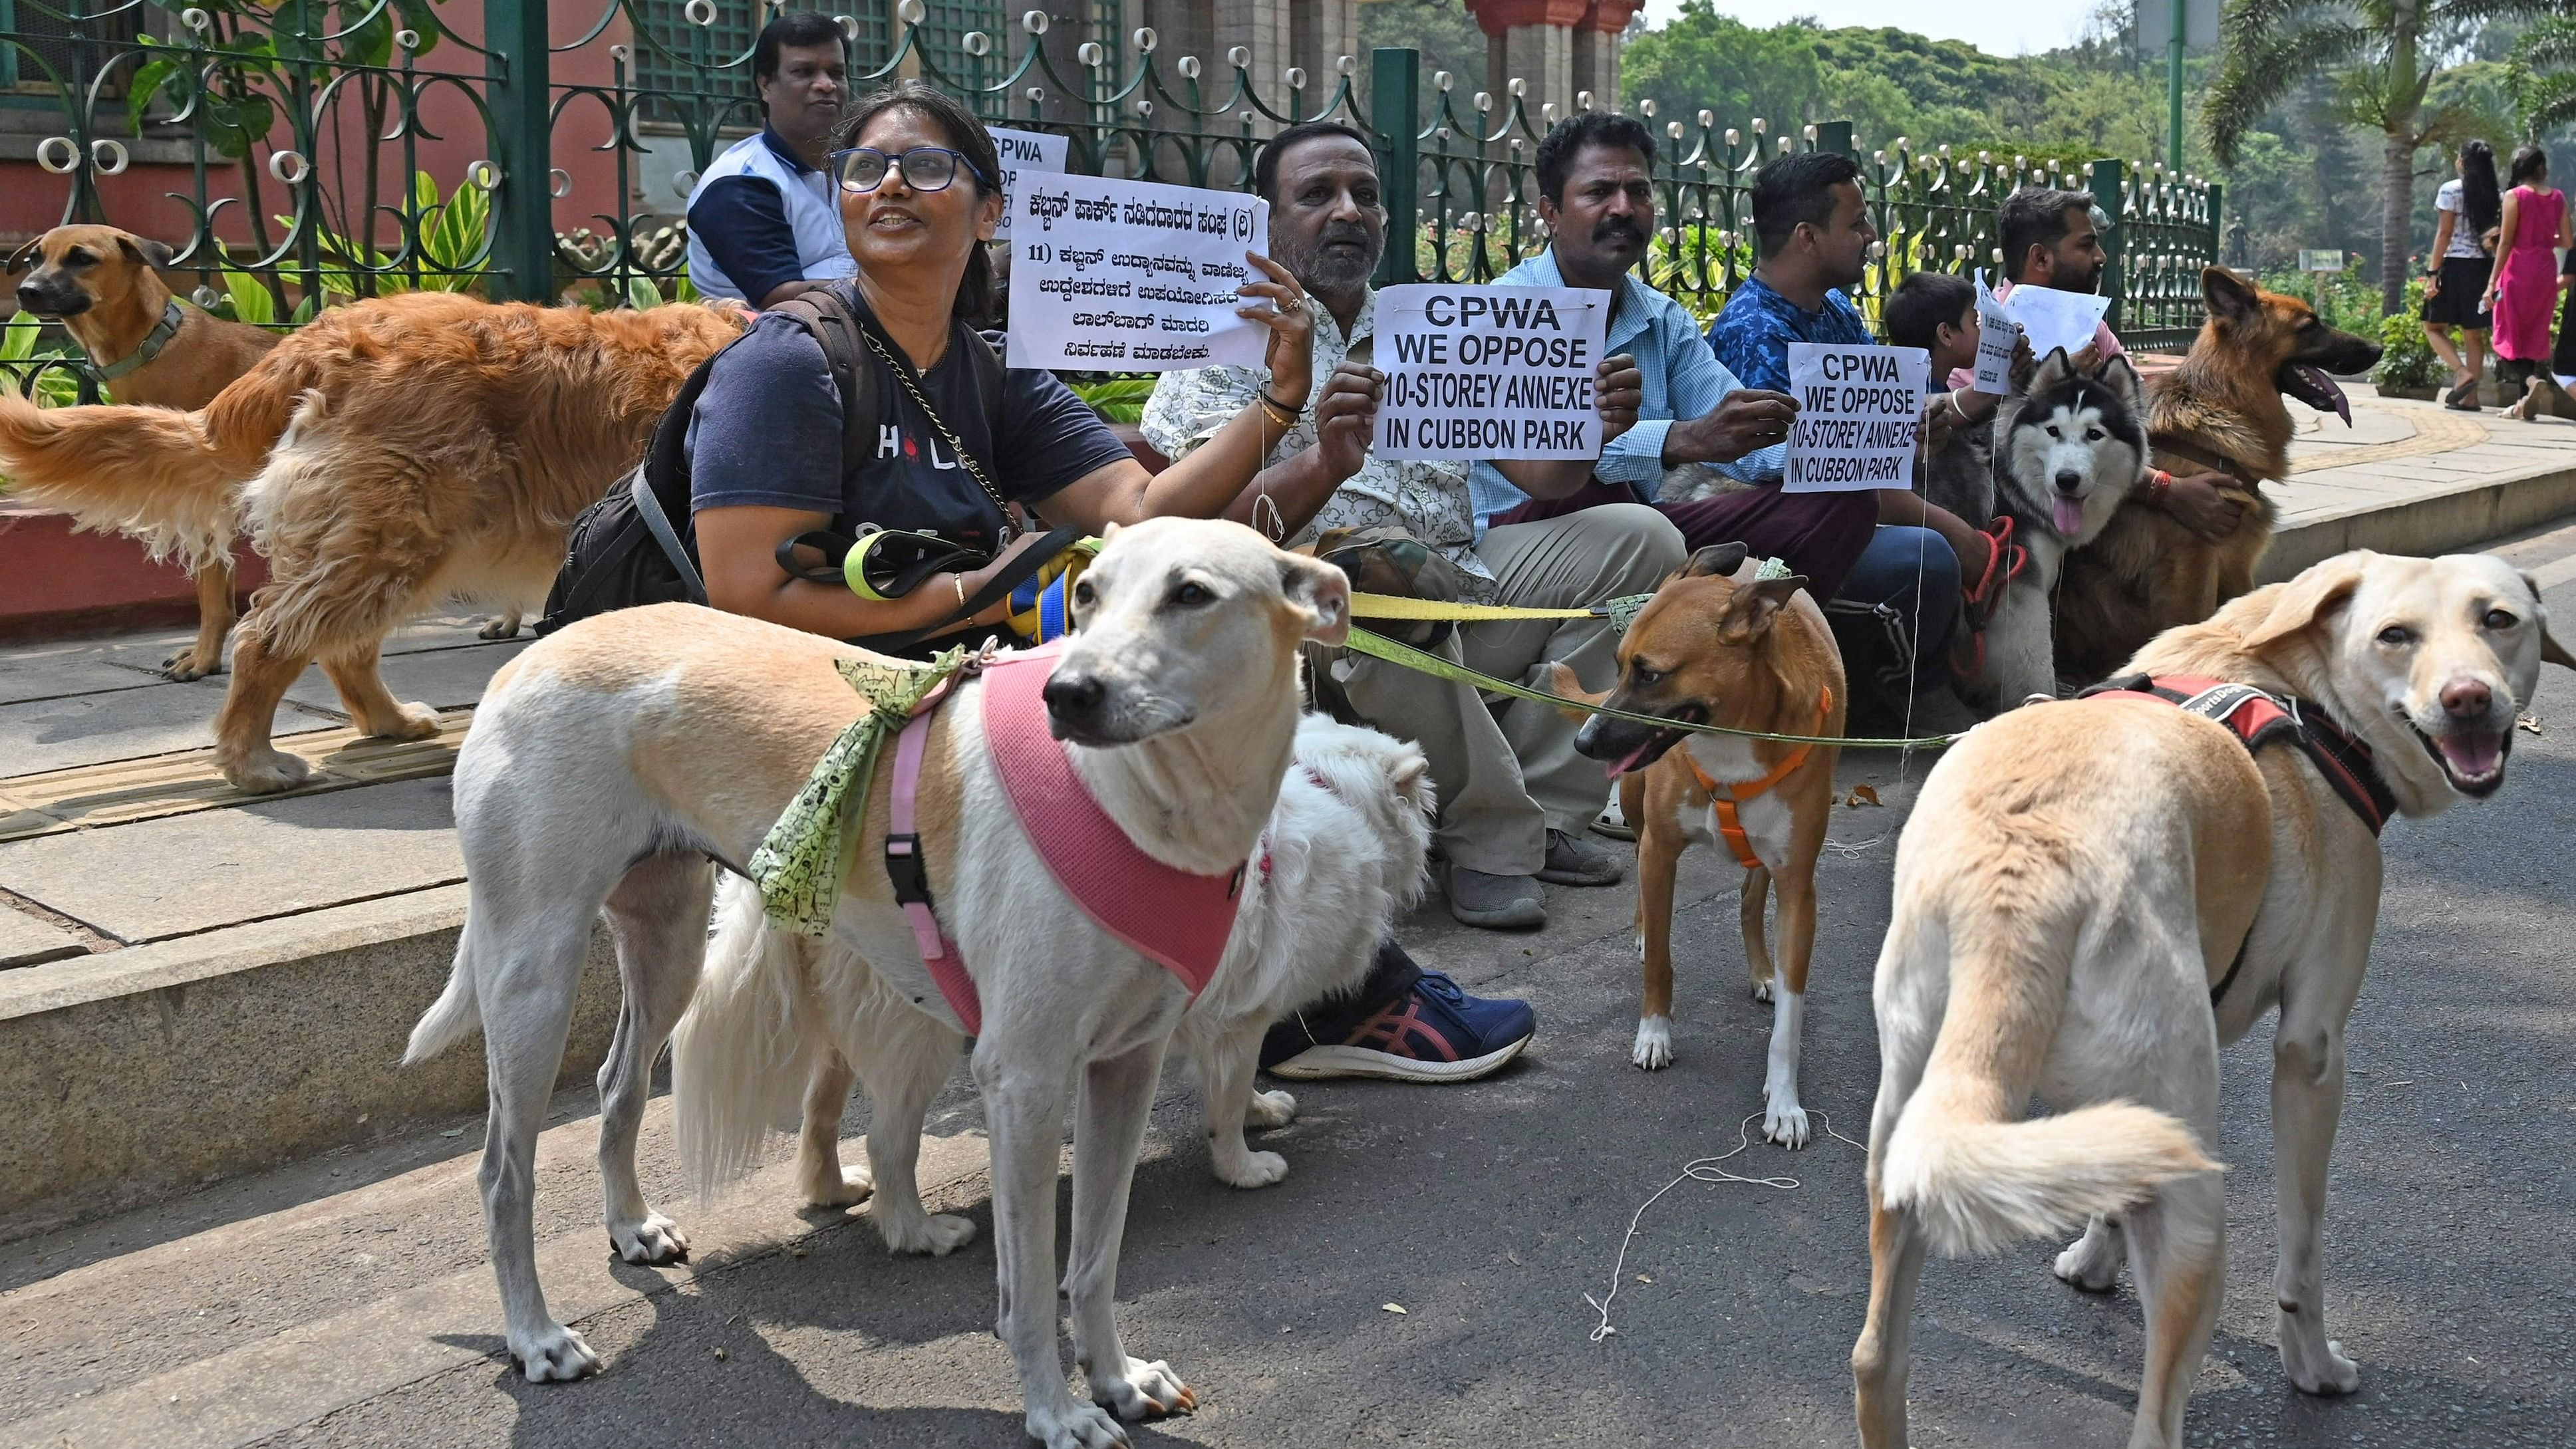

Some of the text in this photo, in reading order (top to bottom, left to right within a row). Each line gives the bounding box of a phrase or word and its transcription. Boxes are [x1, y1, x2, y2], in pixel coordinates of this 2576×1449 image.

[1030, 187, 1069, 231] ಕಬ್ಬನ್
[1075, 195, 1117, 223] ಪಾರ್ಕ್
[1124, 196, 1193, 231] ನಡಿಗೆದಾರರ
[1198, 205, 1227, 241] ಸಂಘ
[1233, 207, 1254, 243] (ರಿ)
[1028, 243, 1248, 285] 11) ಕಬ್ಬನ್ ಉದ್ಯಾನವನ್ನು ವಾಣಿಜ್ಯ
[1039, 277, 1131, 301] ಉದ್ದೇಶಗಳಿಗೆ
[1161, 315, 1209, 333] ಮಾದರಿ
[1425, 295, 1561, 330] CPWA
[1064, 339, 1210, 360] ನಿರ್ವಹಣೆ ಮಾಡಬೇಕು.
[1395, 334, 1586, 368] WE OPPOSE
[1822, 354, 1900, 382] CPWA
[1384, 372, 1593, 410] 10-STOREY ANNEXE
[1805, 386, 1915, 414] WE OPPOSE
[1387, 418, 1586, 450] IN CUBBON PARK
[1792, 420, 1917, 449] 10-STOREY ANNEXE
[1791, 456, 1902, 483] IN CUBBON PARK
